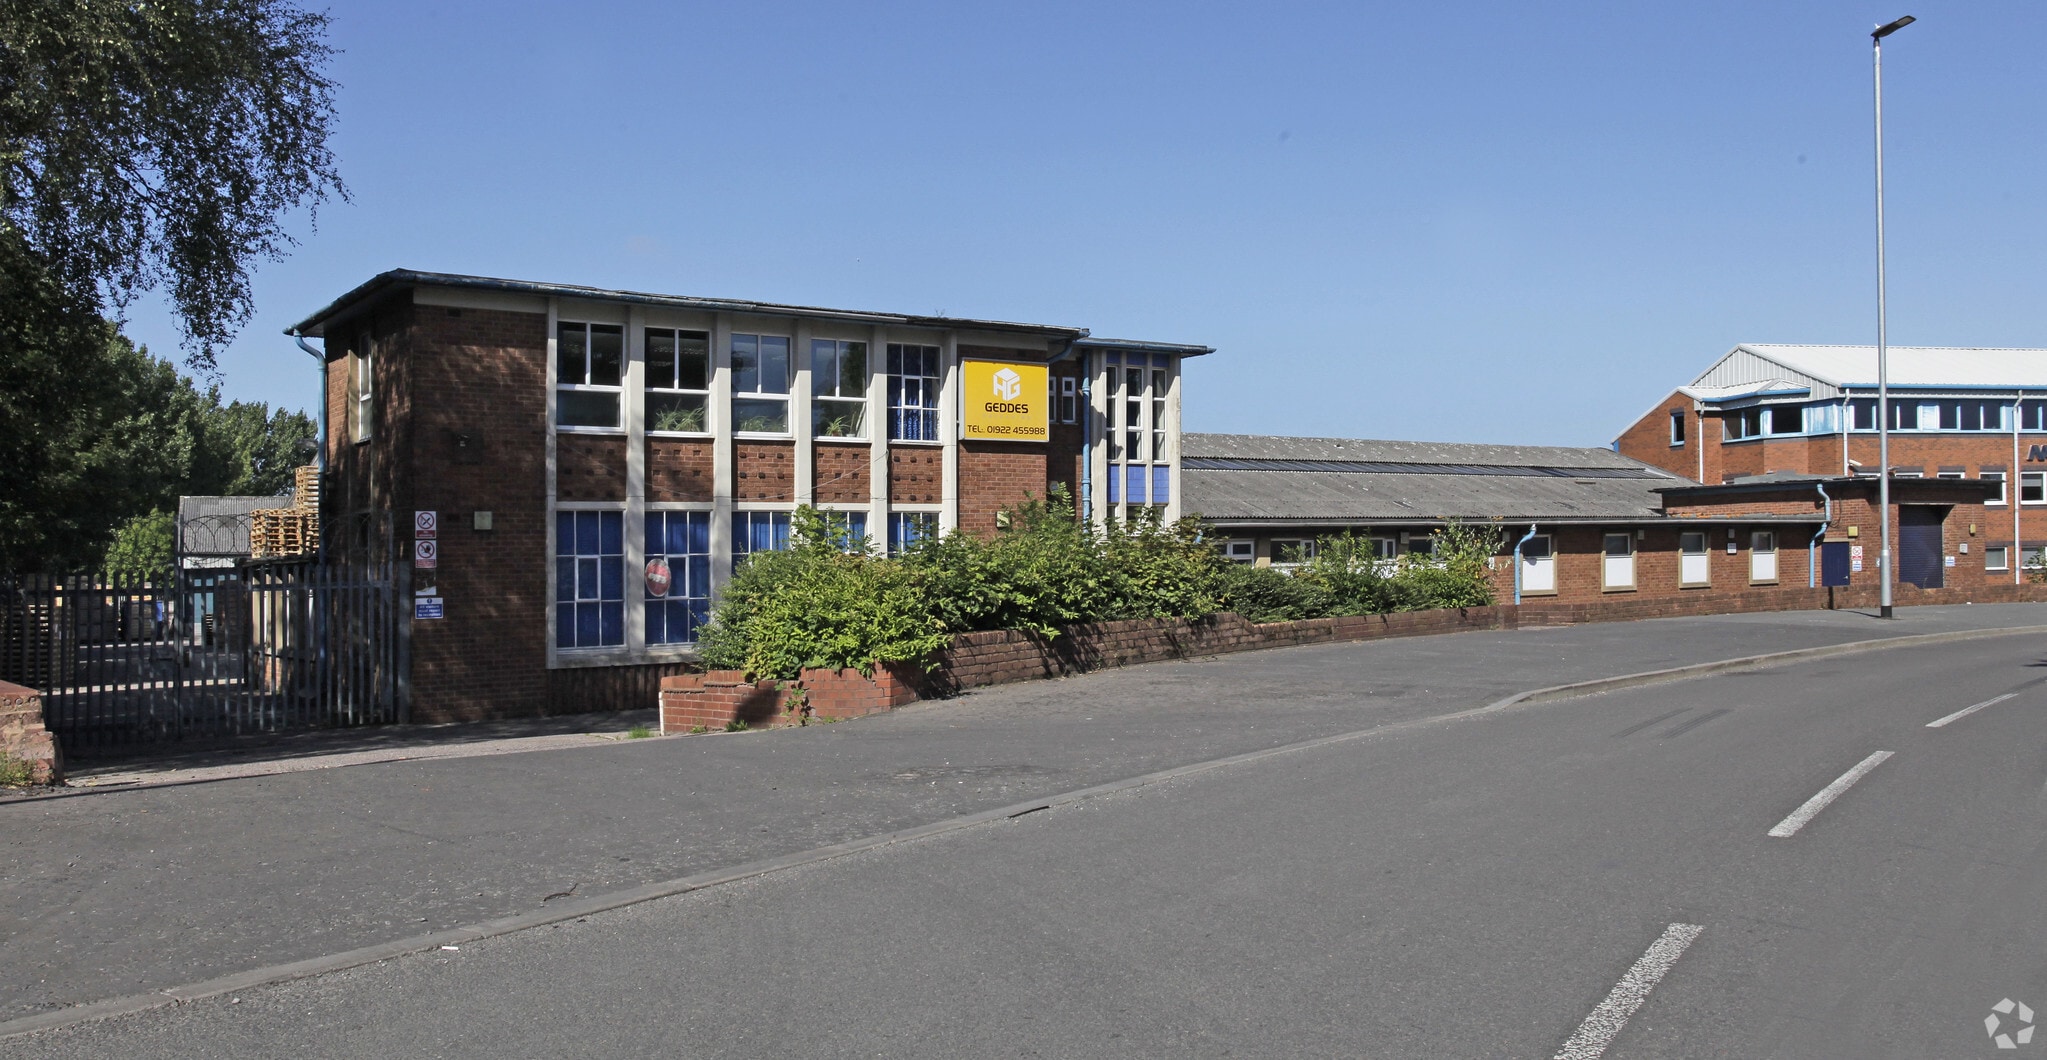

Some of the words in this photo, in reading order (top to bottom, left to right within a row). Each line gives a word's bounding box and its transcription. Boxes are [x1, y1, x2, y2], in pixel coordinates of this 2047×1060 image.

[985, 402, 1029, 414] GEDDES
[986, 426, 1011, 434] 01922
[1013, 426, 1046, 435] 455988
